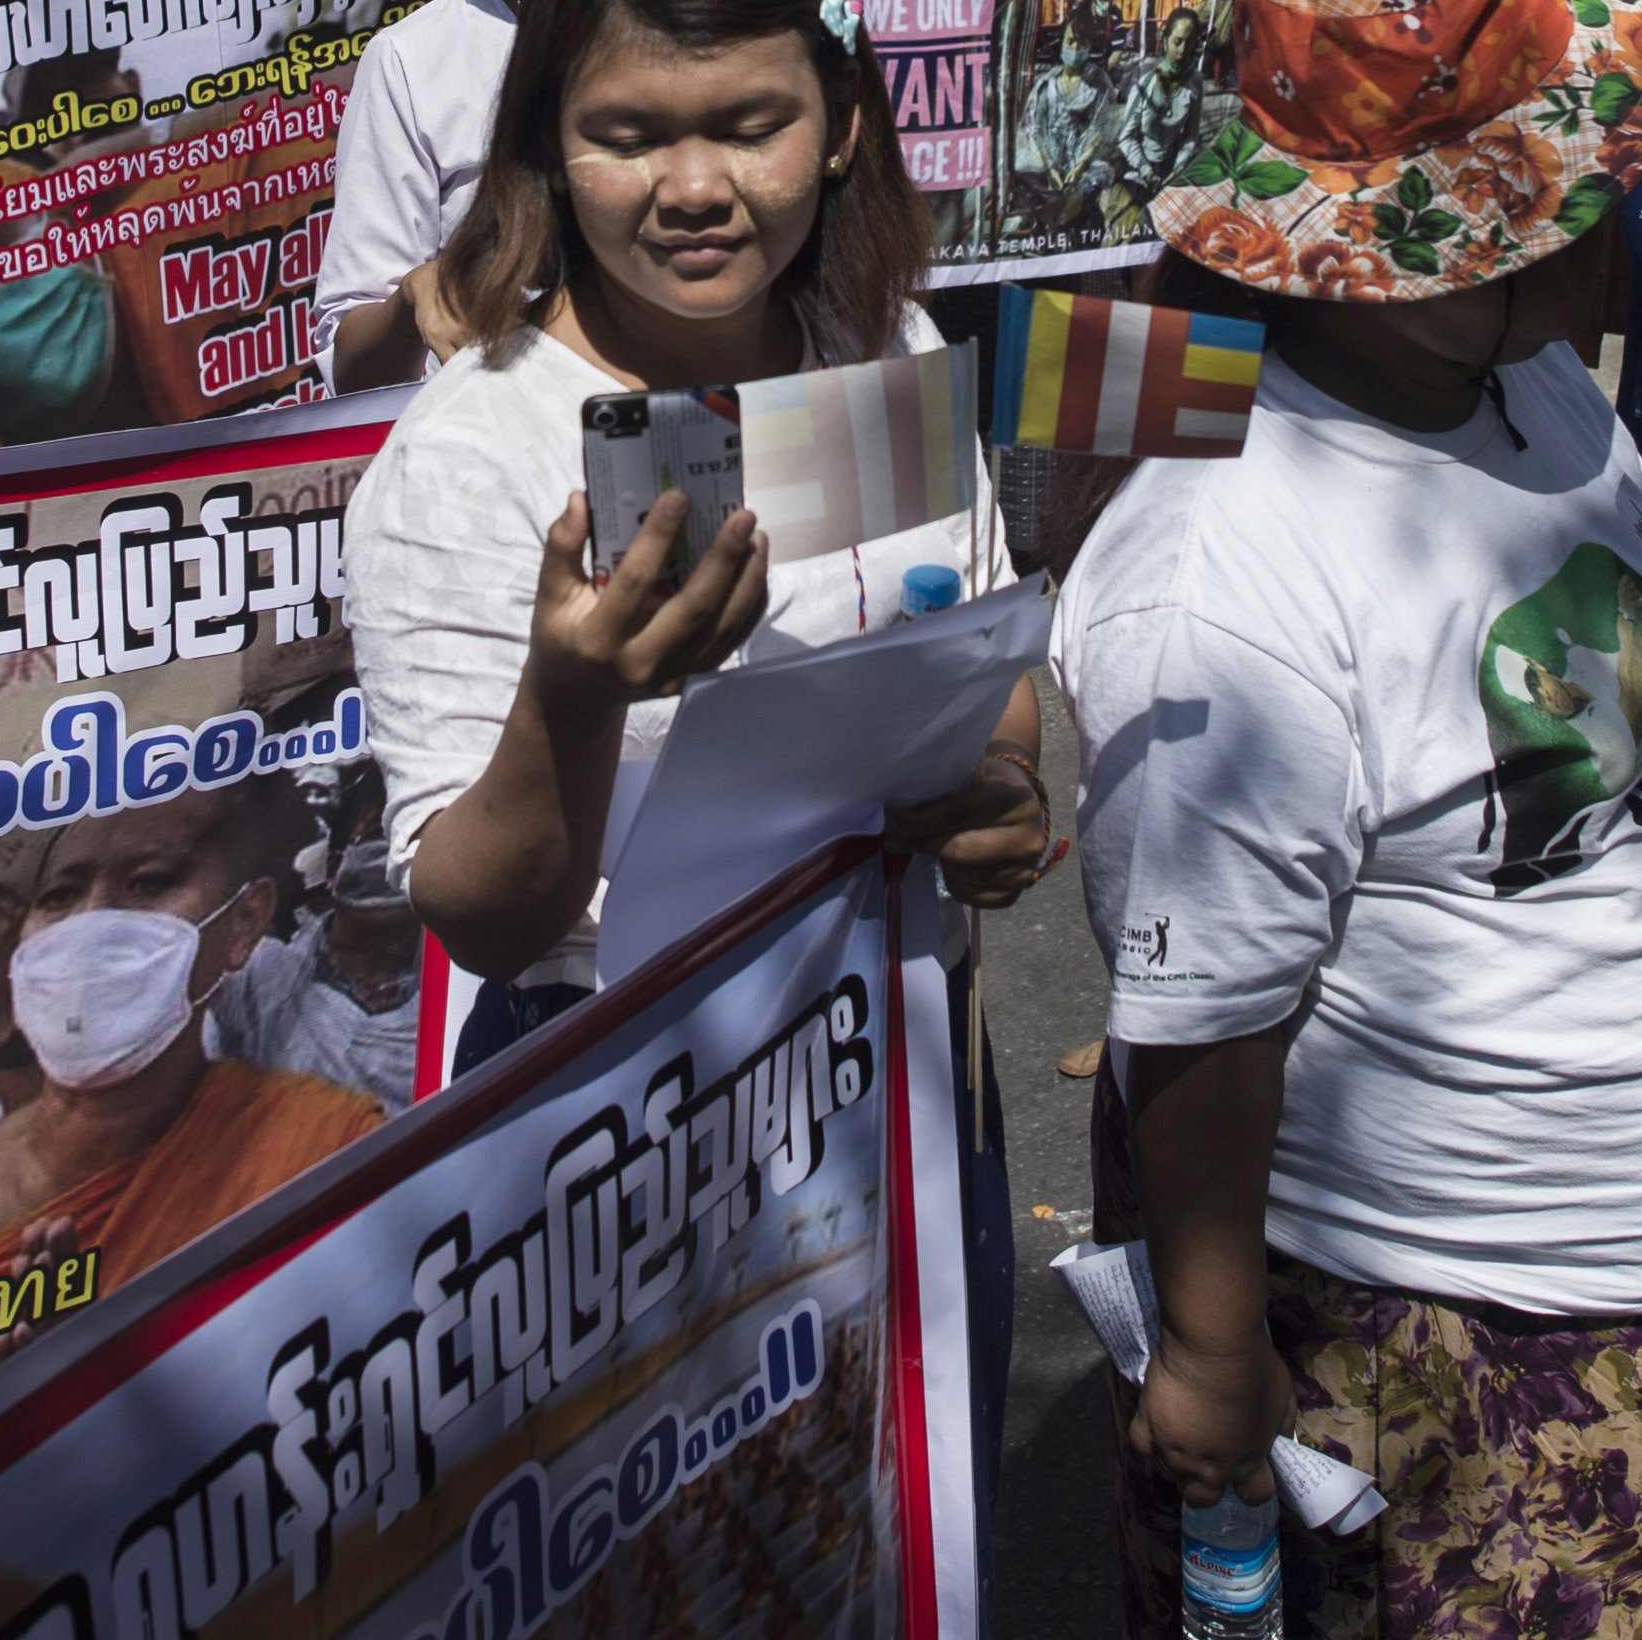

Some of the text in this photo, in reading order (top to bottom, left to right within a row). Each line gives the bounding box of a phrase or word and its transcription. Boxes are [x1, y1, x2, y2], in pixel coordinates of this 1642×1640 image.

[900, 140, 951, 184] CE
[160, 238, 271, 325] May
[198, 306, 287, 397] and
[1120, 926, 1152, 943] CIMB
